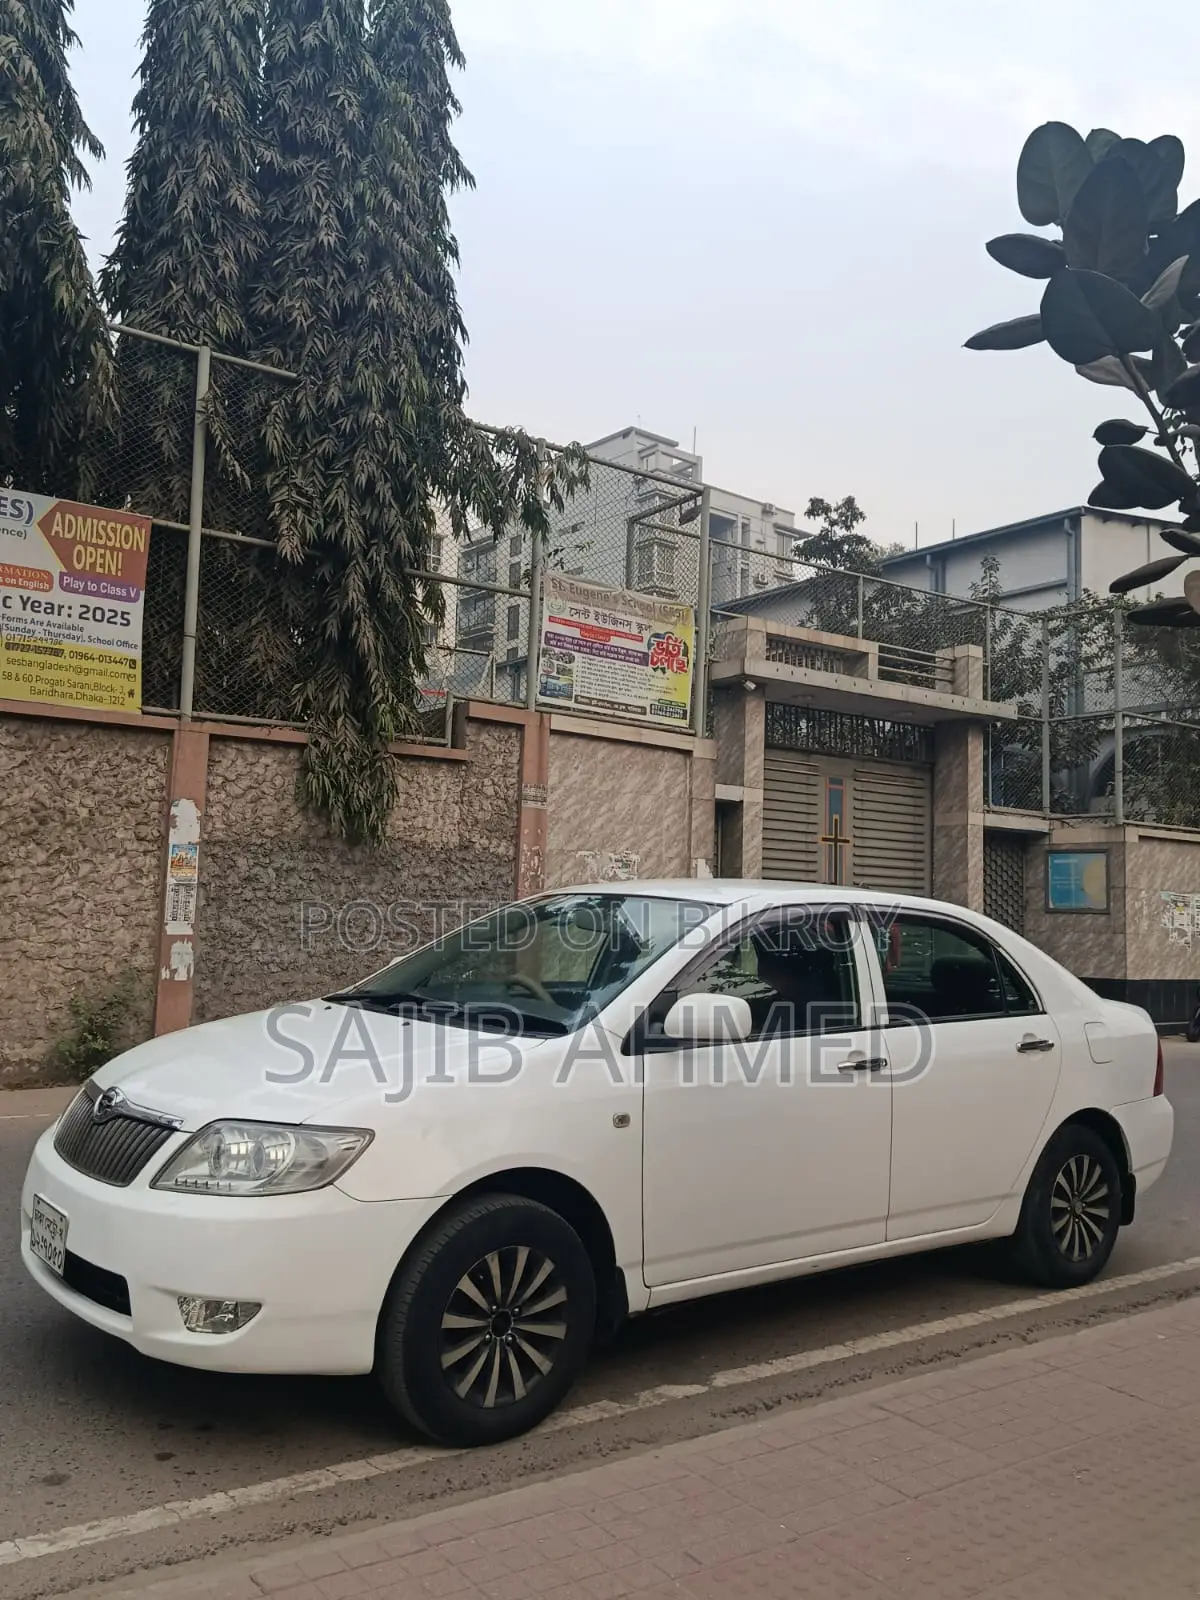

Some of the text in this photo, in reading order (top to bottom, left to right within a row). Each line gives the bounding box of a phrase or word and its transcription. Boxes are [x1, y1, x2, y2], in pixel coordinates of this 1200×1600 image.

[0, 526, 27, 540] nce)
[51, 511, 146, 553] ADMISSION
[73, 544, 123, 577] OPEN!
[5, 577, 17, 585] on
[18, 578, 50, 591] English
[63, 575, 137, 598] Play to Class V
[18, 594, 72, 618] Year:
[78, 604, 131, 627] 2025
[2, 613, 85, 633] Forms Are Available
[87, 635, 115, 646] School
[116, 640, 139, 650] Office
[6, 657, 128, 679] sesbangladesh@gmail.com
[2, 671, 13, 681] 58
[15, 673, 20, 682] &
[22, 673, 34, 683] 60
[35, 674, 65, 687] Progati
